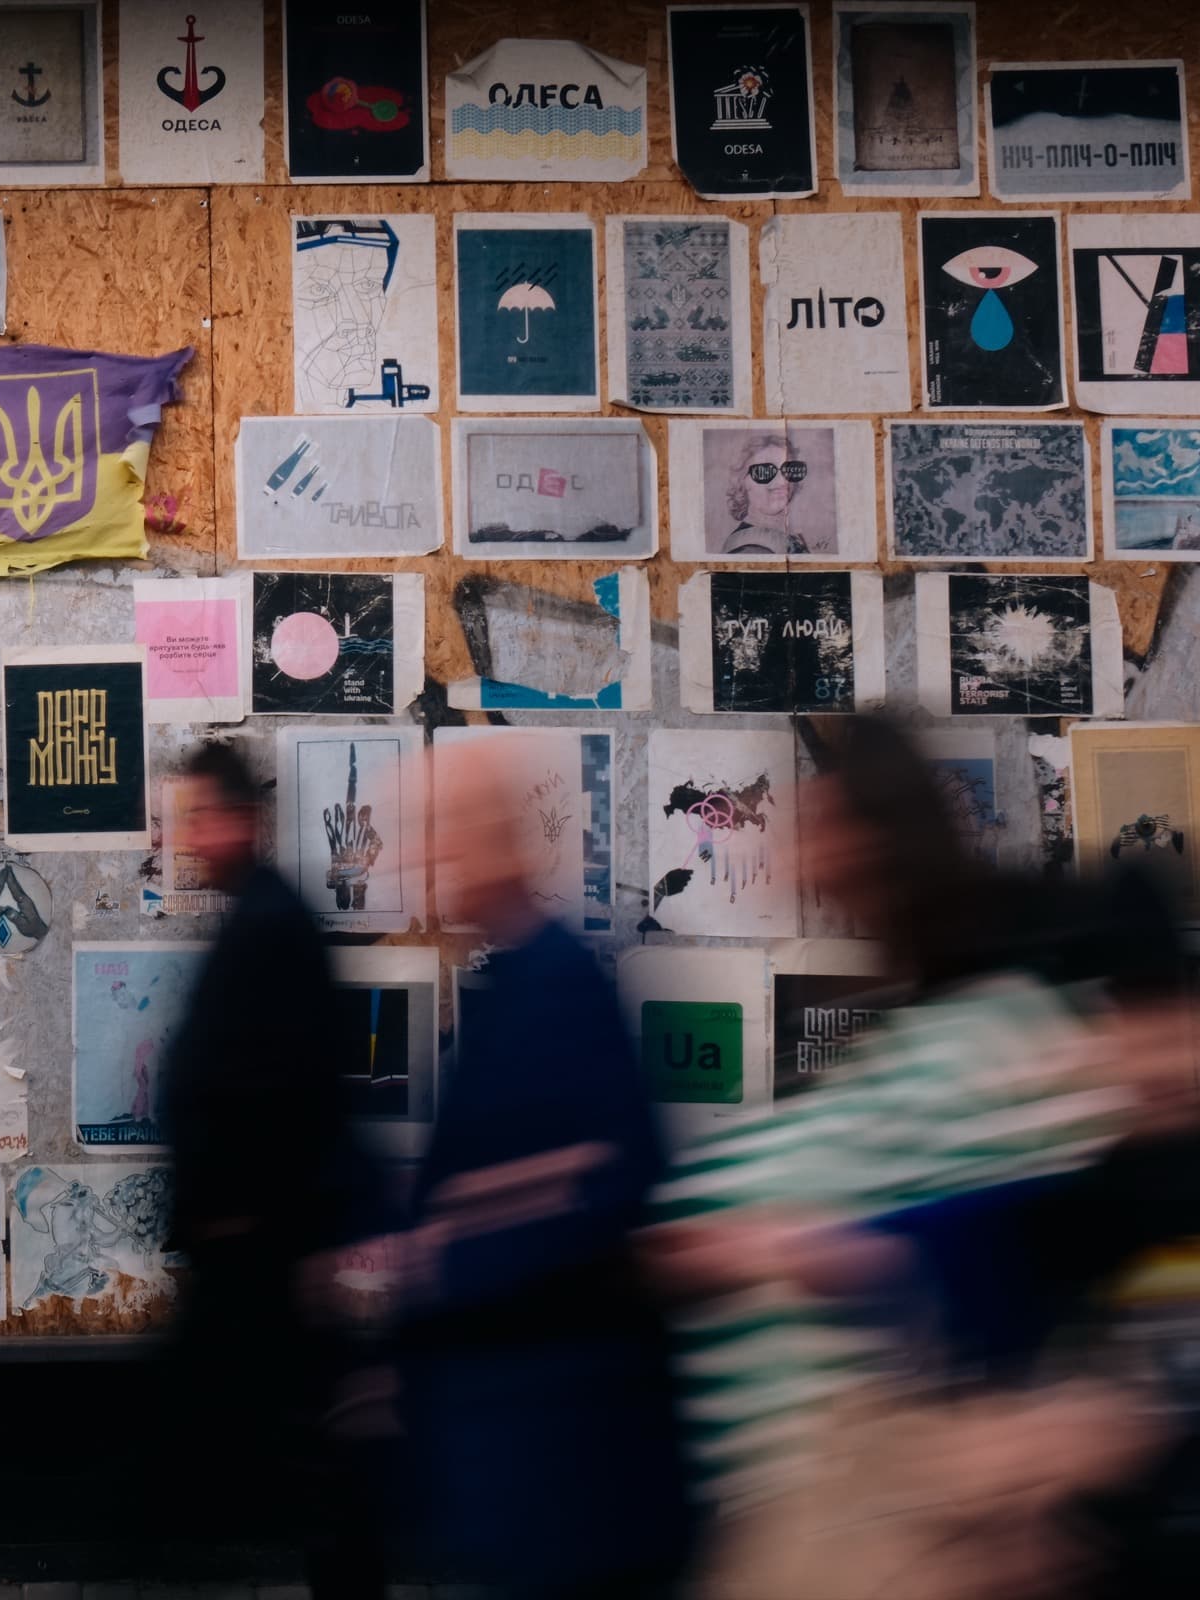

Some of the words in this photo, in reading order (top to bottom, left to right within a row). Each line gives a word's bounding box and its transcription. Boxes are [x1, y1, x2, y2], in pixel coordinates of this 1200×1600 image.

[161, 119, 222, 132] ОДЕСА
[724, 144, 764, 155] ODESA
[786, 286, 886, 330] ЛІТО
[724, 618, 770, 640] ТУТ
[781, 618, 845, 639] ЛЮДИ
[343, 679, 365, 687] stand
[959, 690, 1010, 698] TERRORIST
[663, 1031, 723, 1071] Ua
